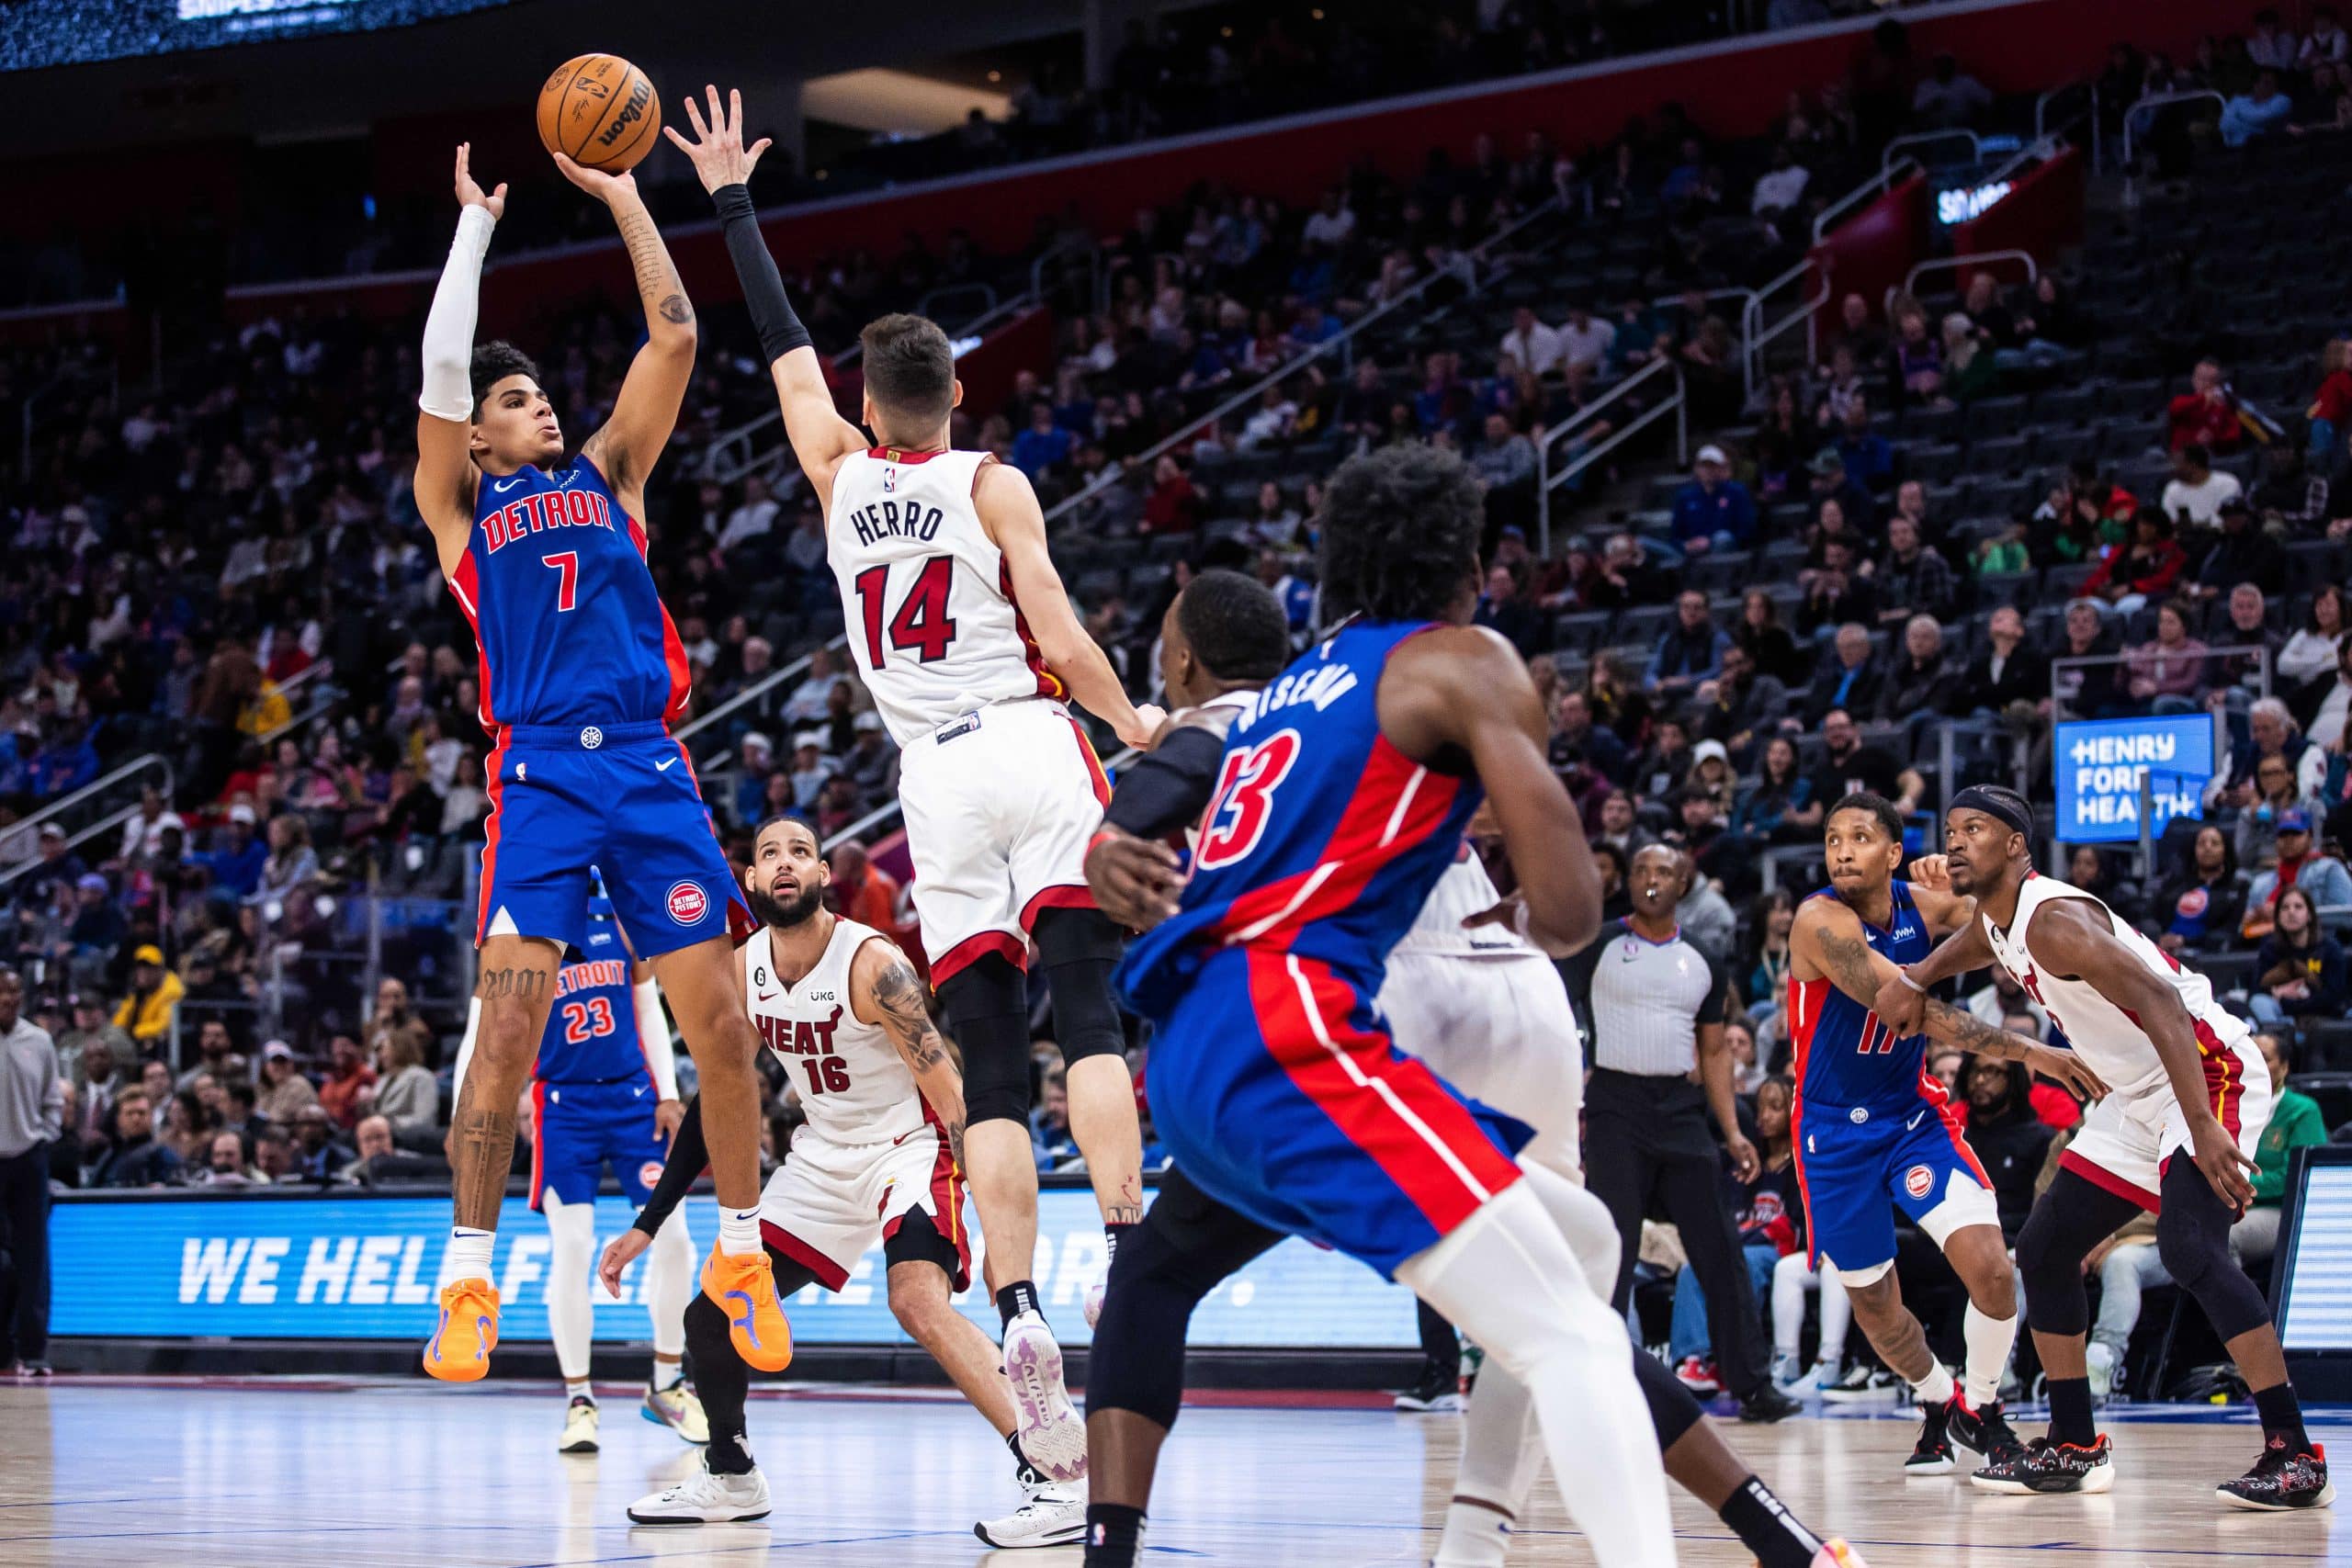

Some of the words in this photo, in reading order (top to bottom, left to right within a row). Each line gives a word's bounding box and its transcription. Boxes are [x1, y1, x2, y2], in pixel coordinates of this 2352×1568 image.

[598, 79, 650, 146] Wilson
[480, 490, 616, 556] DETROIT
[850, 501, 944, 547] HERRO
[541, 550, 579, 613] 7
[854, 554, 956, 671] 14
[2072, 732, 2177, 765] HENRY
[2076, 792, 2197, 825] HEATH
[1893, 925, 1917, 941] JWM
[553, 959, 626, 999] ETROIT
[561, 996, 616, 1045] 23
[755, 1004, 844, 1055] HEAT
[801, 1055, 851, 1096] 16
[178, 1237, 291, 1304] WE
[295, 1237, 458, 1304] HEL
